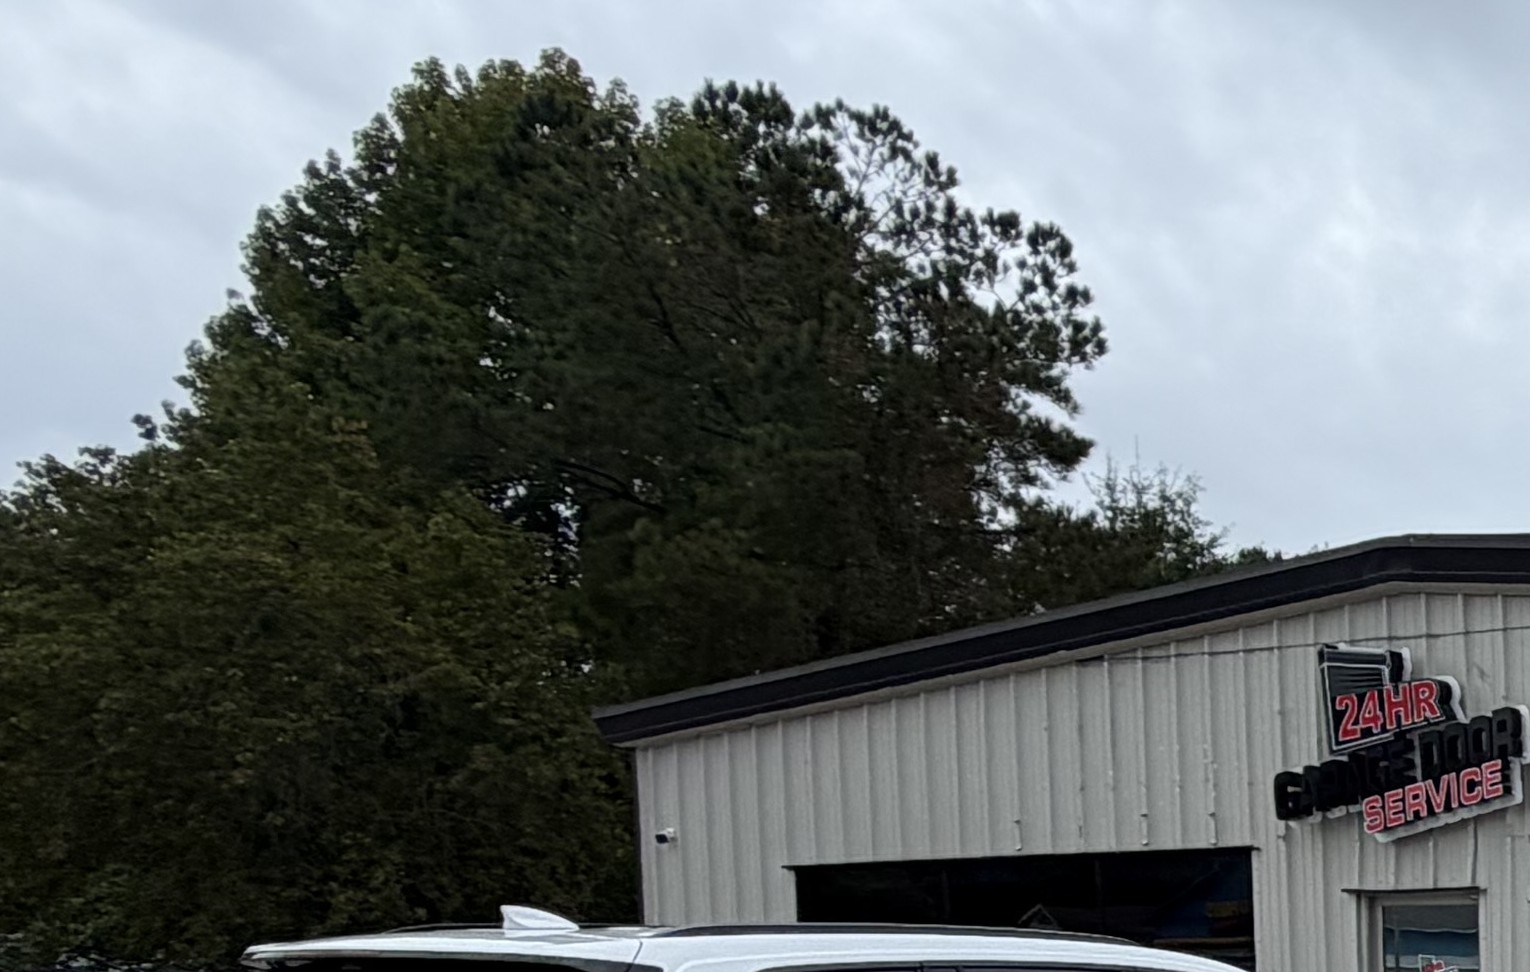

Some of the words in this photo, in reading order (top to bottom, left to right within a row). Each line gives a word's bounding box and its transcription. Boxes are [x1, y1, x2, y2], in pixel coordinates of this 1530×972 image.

[1335, 679, 1440, 742] 24HR
[1418, 706, 1522, 777] DOOR
[1362, 759, 1503, 834] SERVICE
